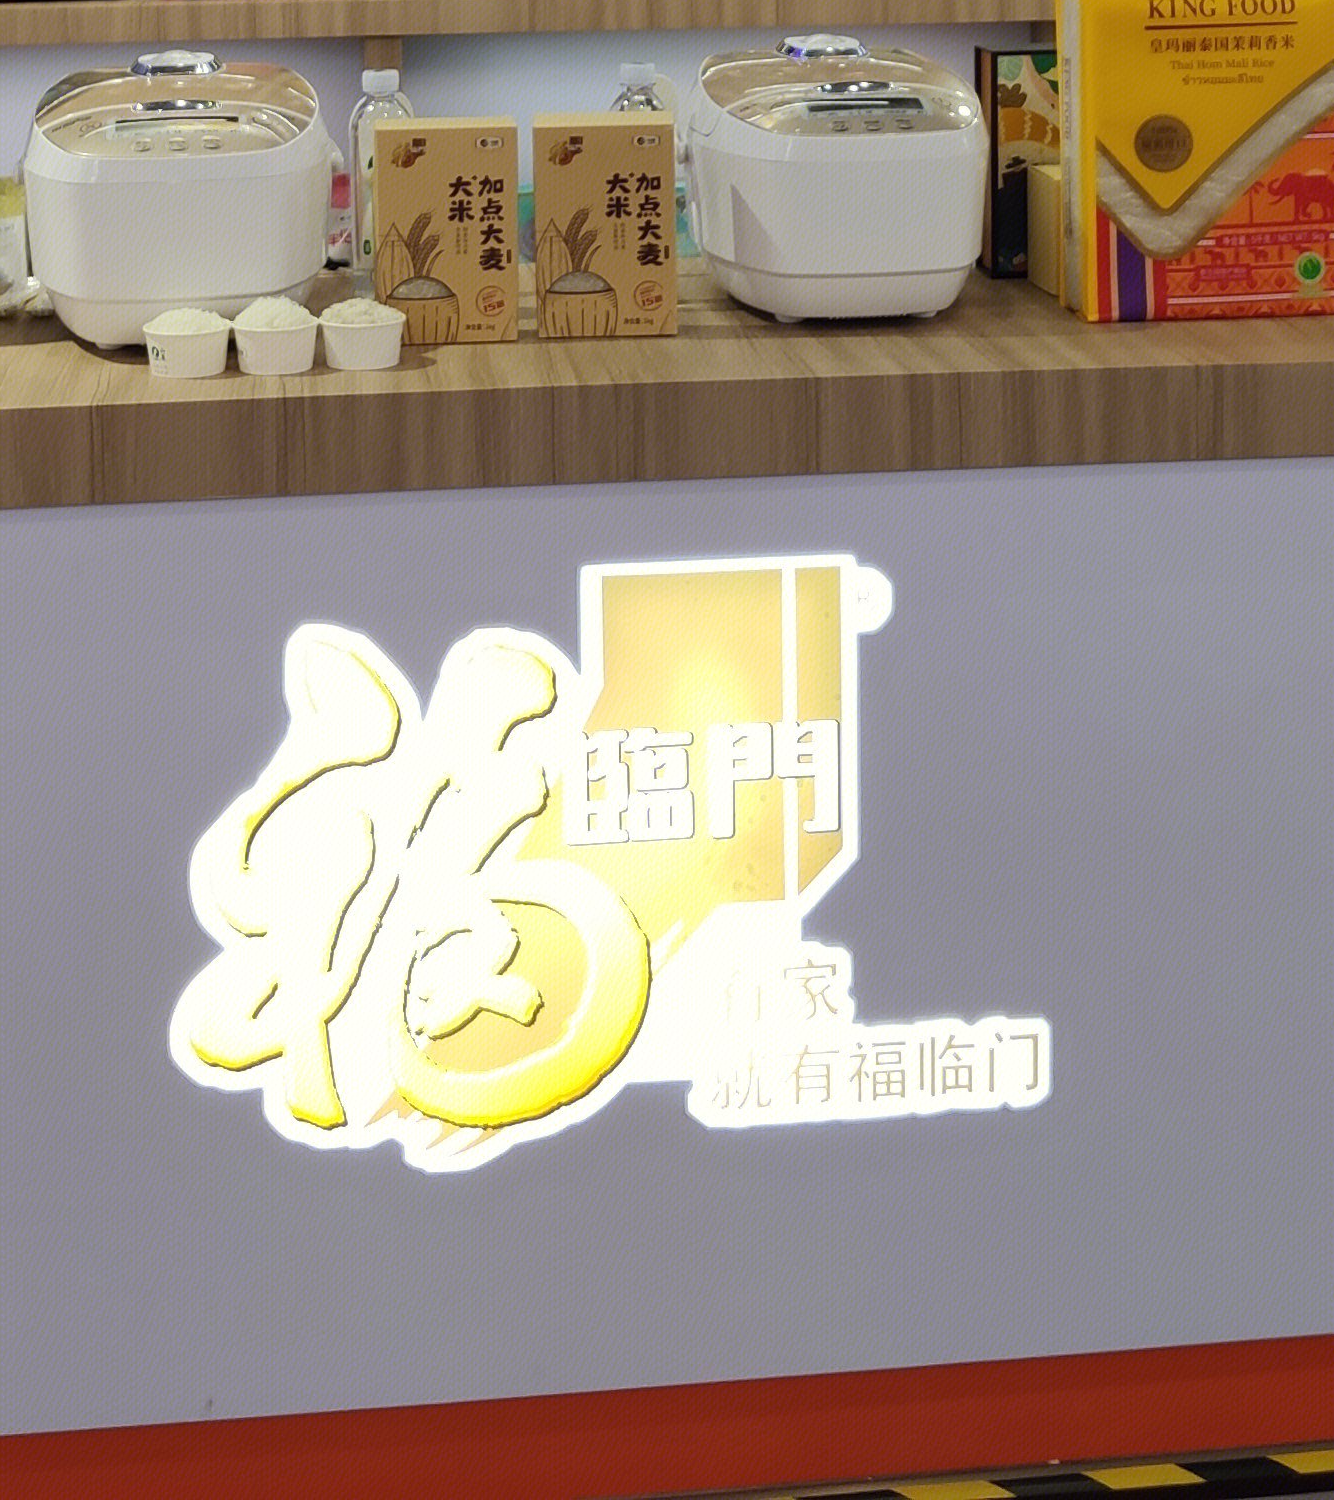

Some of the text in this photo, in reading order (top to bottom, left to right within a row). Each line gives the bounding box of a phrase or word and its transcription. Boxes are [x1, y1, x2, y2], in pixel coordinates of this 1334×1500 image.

[1150, 33, 1296, 54] 皇玛丽泰国茉莉香米
[1170, 57, 1275, 69] Thai Hom Mali Rice
[448, 175, 475, 223] 大米
[478, 174, 506, 272] 加点大麦
[605, 172, 633, 219] 大米
[635, 172, 664, 267] 加点大麦
[187, 630, 843, 1132] 福 臨門
[709, 1030, 1045, 1113] 就有福临门
